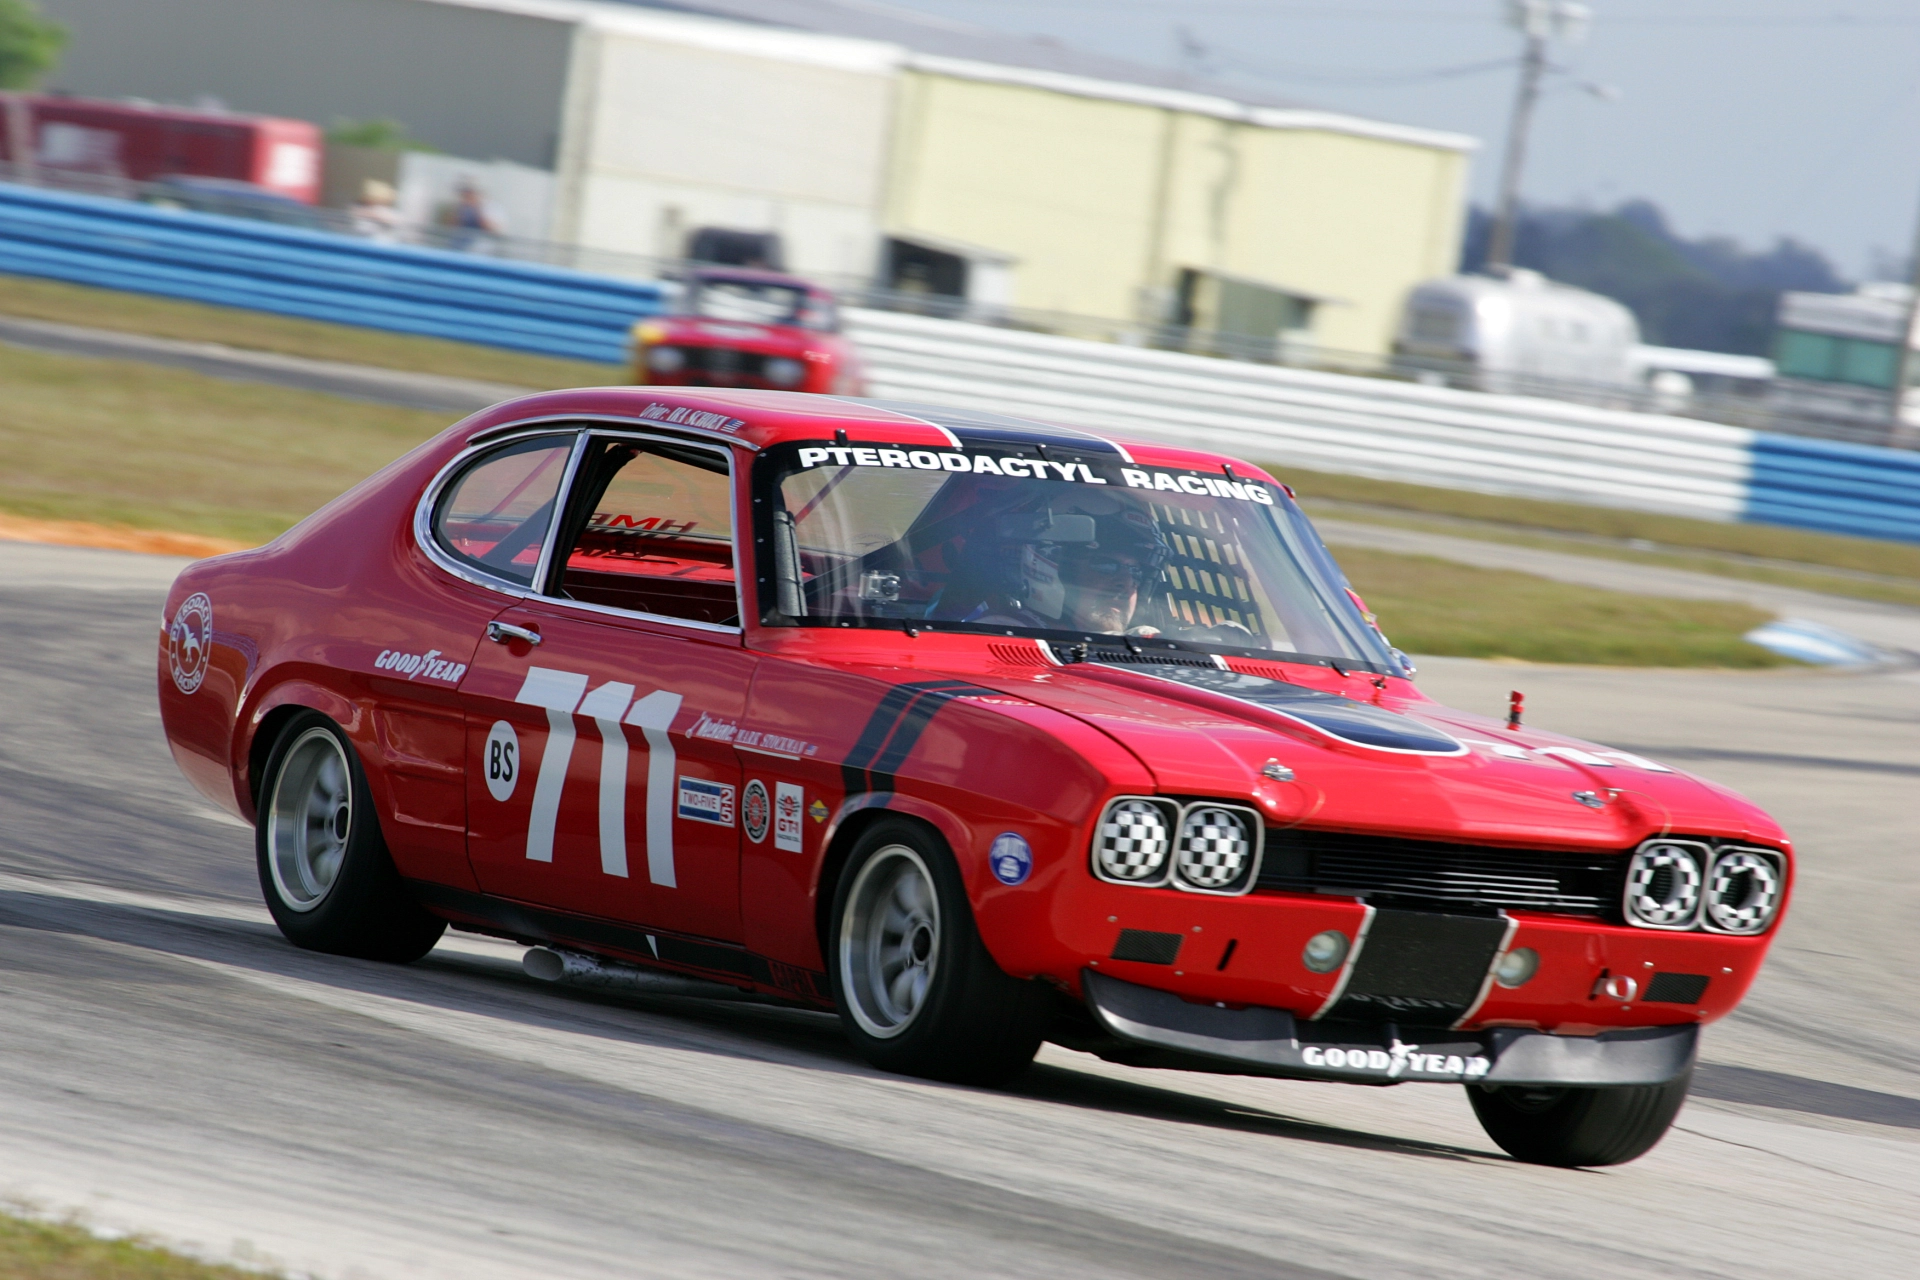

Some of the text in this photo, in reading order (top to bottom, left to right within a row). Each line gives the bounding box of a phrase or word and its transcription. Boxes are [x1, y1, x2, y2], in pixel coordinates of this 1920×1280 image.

[798, 446, 1274, 506] PTERODACTYL RACING
[174, 666, 202, 691] RACING
[374, 648, 467, 684] GOODYEAR
[490, 739, 515, 782] BS
[515, 666, 683, 889] 711
[683, 791, 717, 810] TWO-FIVE
[1301, 1042, 1492, 1077] GOODYEAR
